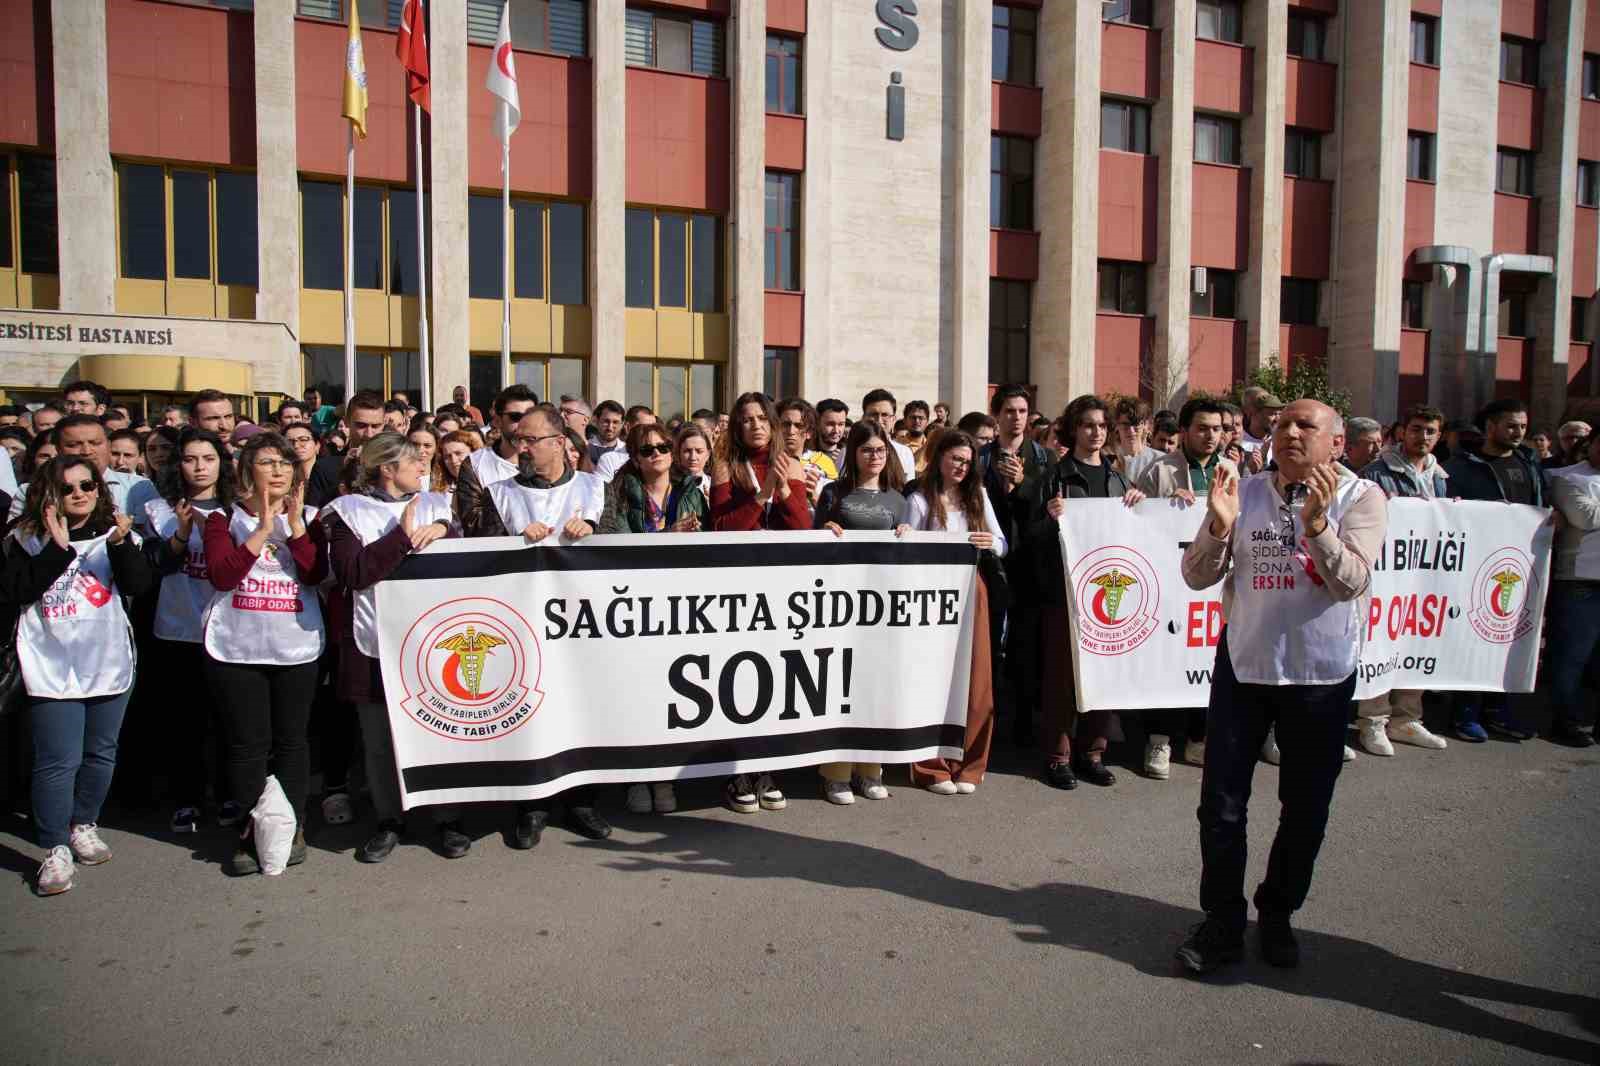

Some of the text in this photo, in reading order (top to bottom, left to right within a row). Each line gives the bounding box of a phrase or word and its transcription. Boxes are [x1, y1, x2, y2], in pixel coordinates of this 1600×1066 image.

[79, 327, 173, 345] HASTANESİ
[1253, 562, 1293, 574] SONA
[238, 597, 266, 609] TABİP
[545, 578, 960, 641] SAĞLIKTA ŞİDDETE
[667, 647, 853, 730] SON!
[428, 695, 447, 713] TÜRK
[493, 689, 520, 714] BİRLİĞİ
[416, 702, 532, 736] EDİRNE TABİP ODASI
